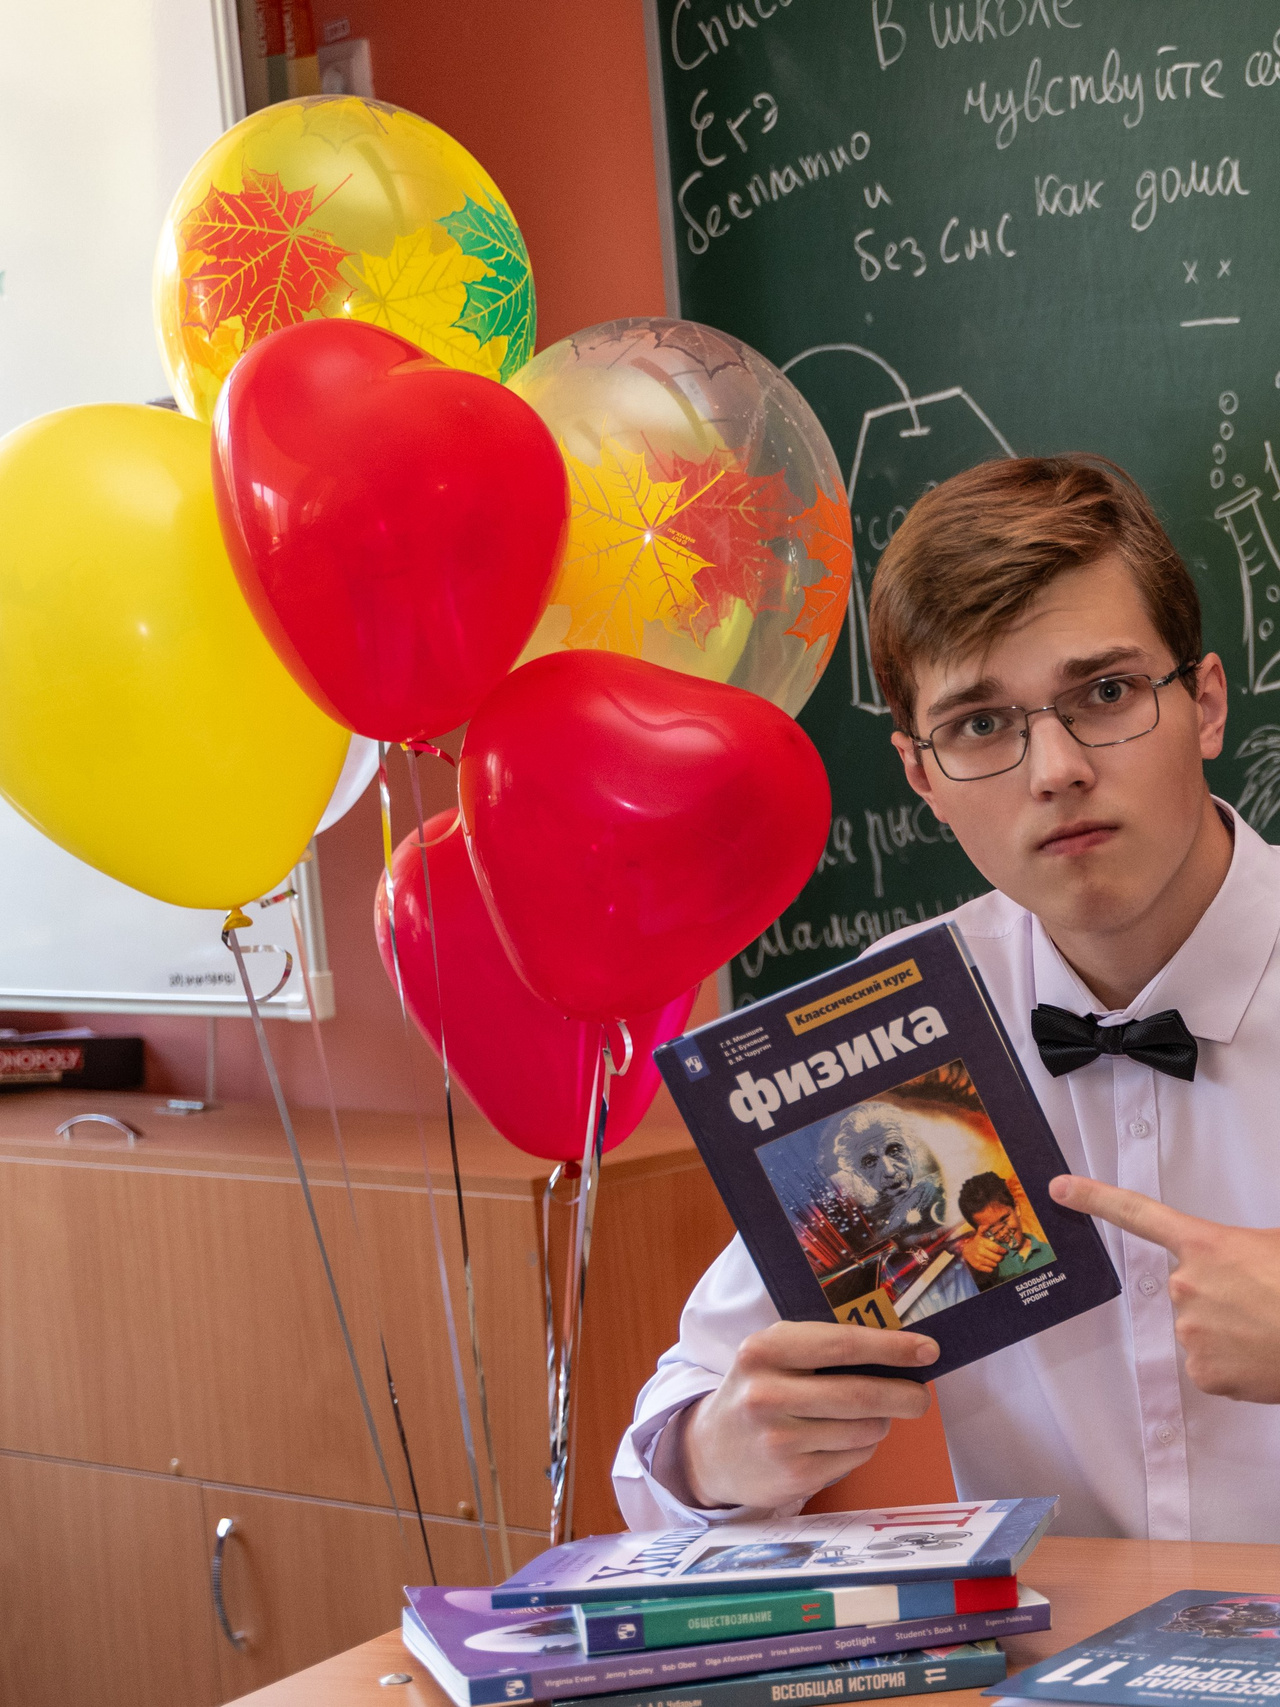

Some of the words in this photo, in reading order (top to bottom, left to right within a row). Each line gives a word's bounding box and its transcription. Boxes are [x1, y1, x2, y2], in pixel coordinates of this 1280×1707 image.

[963, 46, 1225, 149] чувствуйте
[678, 132, 871, 255] бесплатно
[864, 183, 892, 209] и
[1035, 172, 1104, 217] как
[1131, 156, 1250, 232] дома
[854, 229, 927, 281] без
[794, 980, 882, 1026] Классический
[883, 968, 914, 993] курс
[1015, 1272, 1047, 1292] БАЗОВЫЙ
[1022, 1289, 1049, 1306] УРОВНИ
[847, 1299, 887, 1329] 11
[688, 1610, 772, 1629] ОБЩЕСТВОЗНАНИЕ
[801, 1603, 821, 1623] 11
[545, 1676, 573, 1687] Virginia
[575, 1674, 597, 1683] Evans
[605, 1671, 626, 1680] Jenny
[628, 1667, 654, 1677] Dooley
[662, 1662, 676, 1671] Bob
[678, 1660, 697, 1670] Obee
[705, 1657, 721, 1667] Olga
[722, 1652, 763, 1664] Afanasyeva
[770, 1648, 787, 1657] Irina
[789, 1643, 822, 1655] Mikheeva
[835, 1635, 877, 1650] Spotlight
[895, 1628, 933, 1641] Student's
[934, 1625, 954, 1636] Book
[958, 1623, 967, 1631] 11
[1006, 1614, 1033, 1626] Publishing
[772, 1679, 843, 1701] ВСЕОБЩАЯ
[850, 1671, 906, 1693] ИСТОРИЯ
[925, 1667, 946, 1684] 11
[1037, 1658, 1130, 1686] 11
